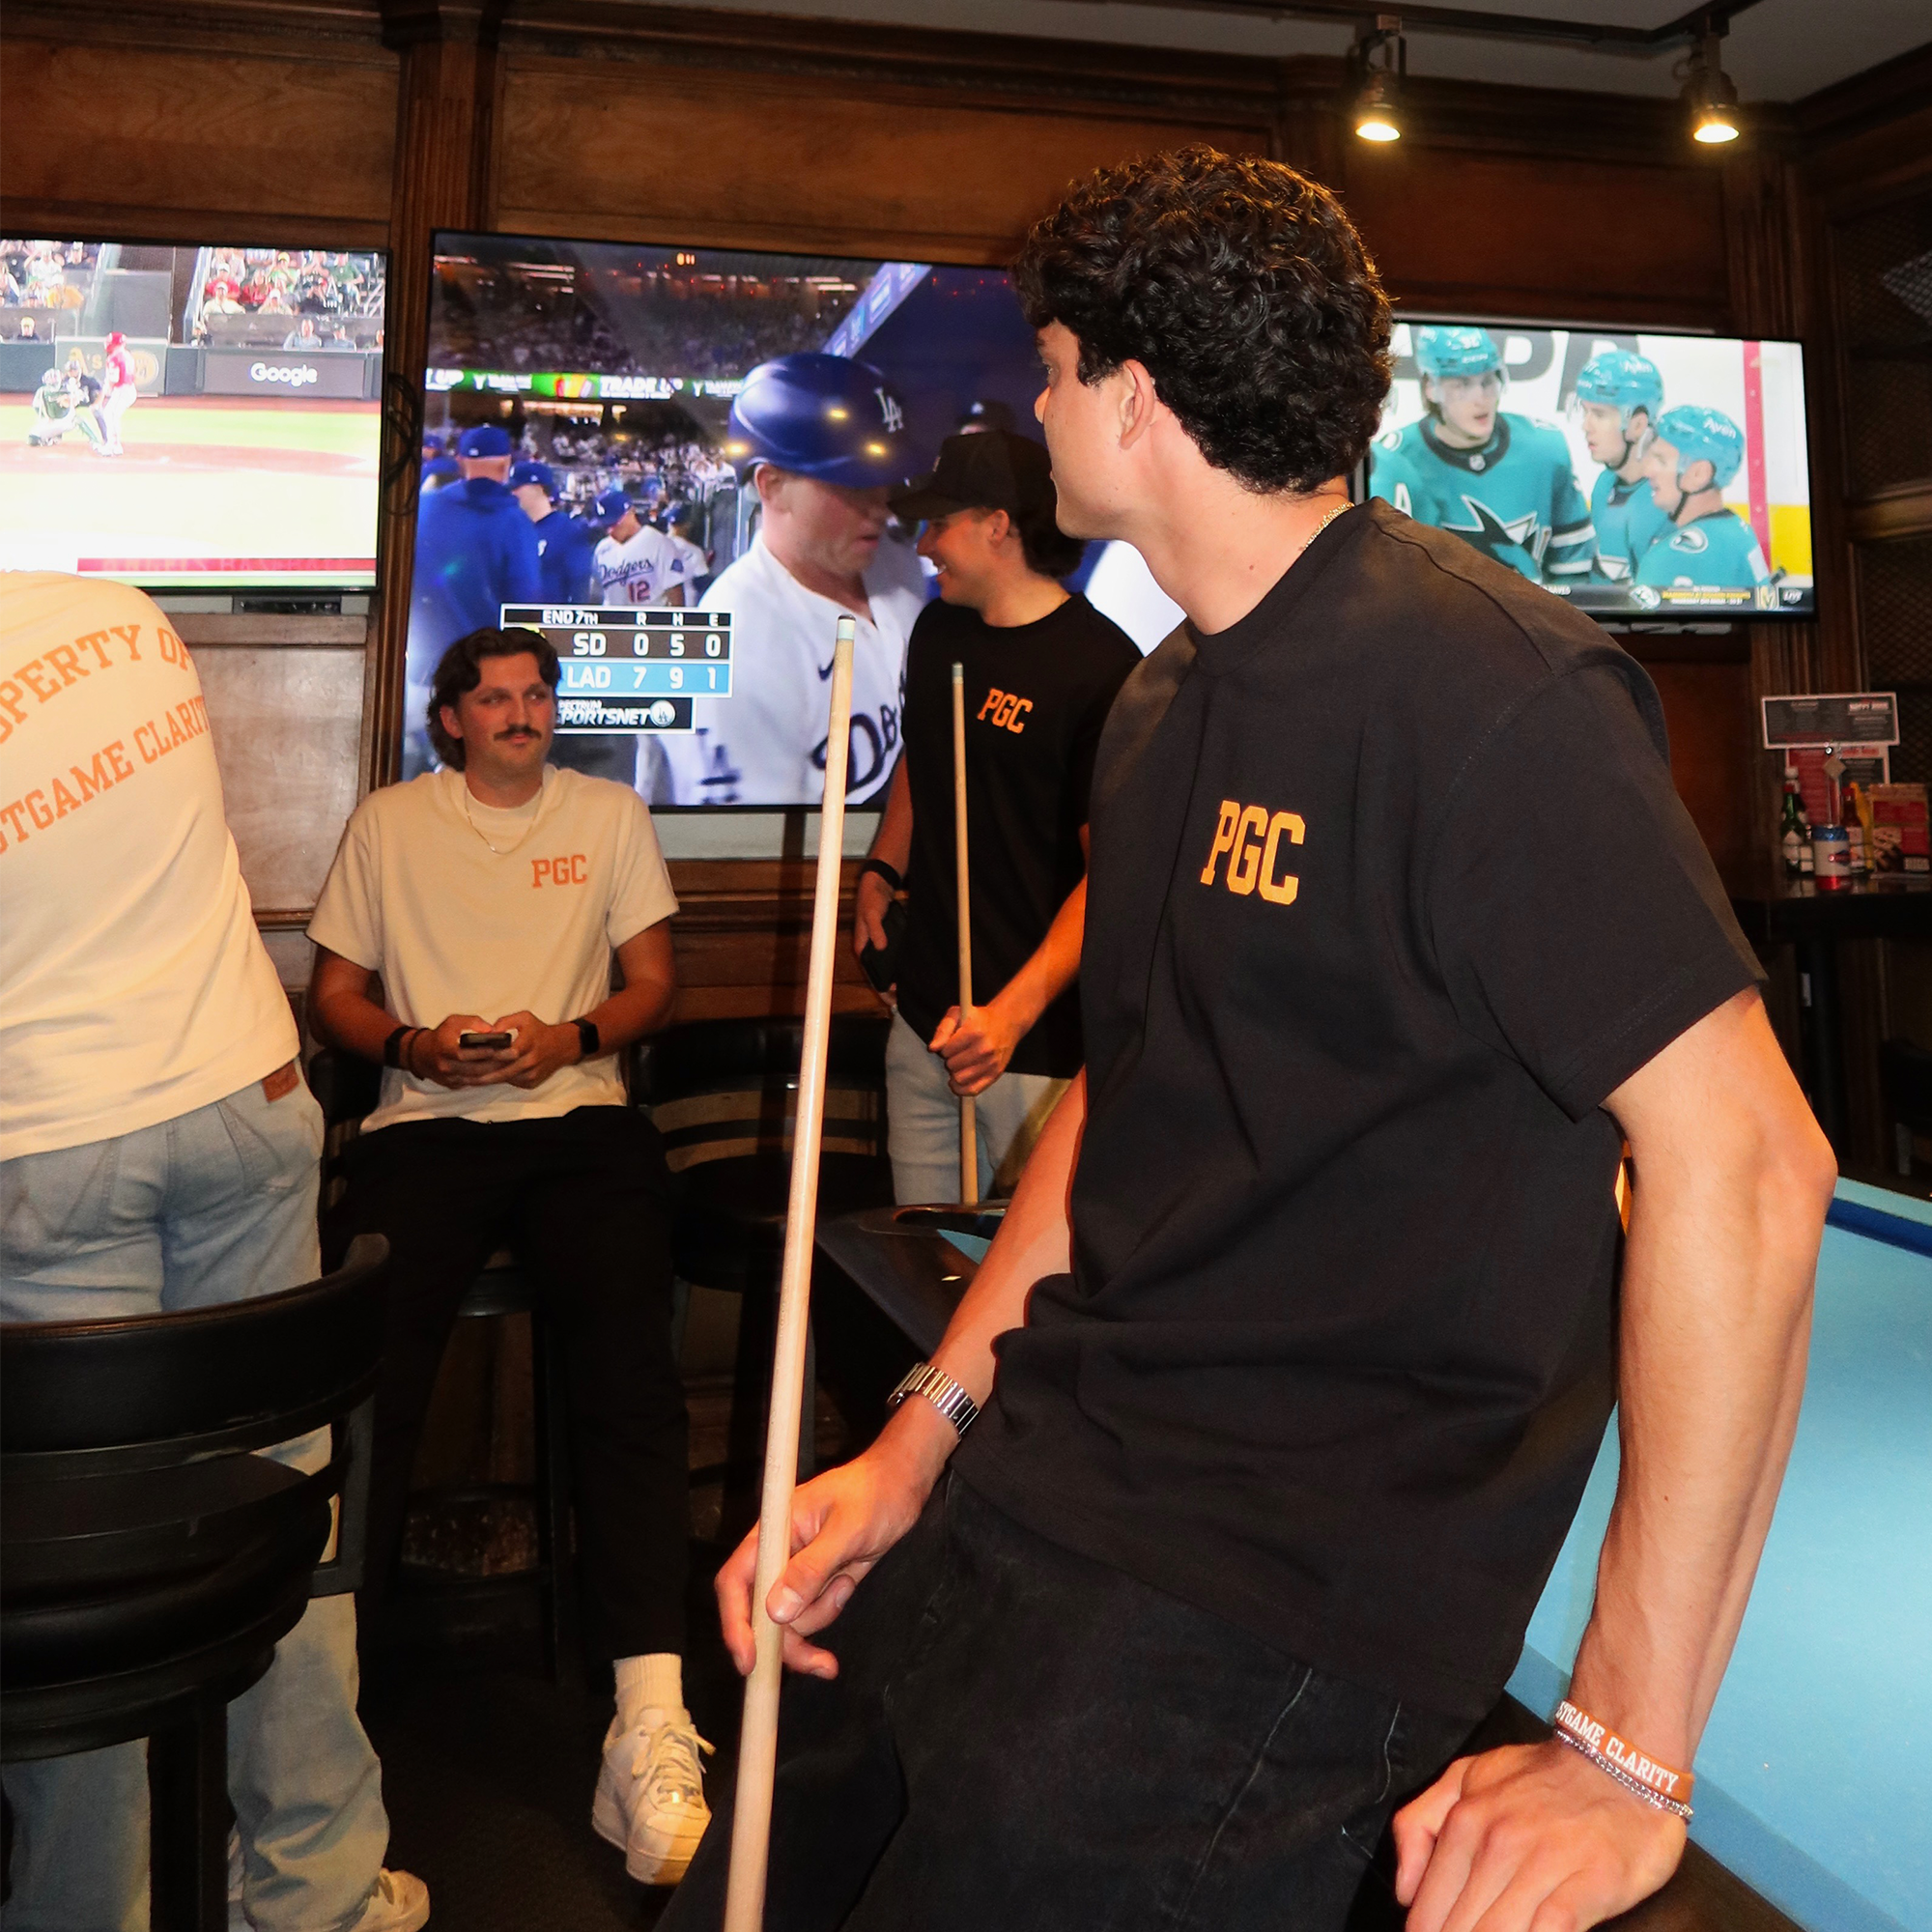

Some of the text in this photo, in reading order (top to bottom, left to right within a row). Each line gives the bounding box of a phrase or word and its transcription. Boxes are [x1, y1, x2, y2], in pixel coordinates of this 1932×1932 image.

[250, 362, 319, 386] Google
[599, 375, 657, 394] TRADE
[599, 558, 655, 587] Dodgers
[628, 580, 651, 603] 12
[542, 610, 575, 625] END
[636, 611, 647, 626] R
[672, 613, 684, 627] H
[708, 614, 719, 627] E
[573, 632, 722, 658] SD 0 5 0
[567, 666, 717, 691] LAD 7 9 1
[555, 707, 651, 725] PORTSNET
[557, 699, 603, 711] PECTRUM
[976, 687, 1034, 734] PGC
[1200, 799, 1306, 905] PGC
[530, 854, 588, 889] PGC
[1605, 1736, 1679, 1794] CLARITY
